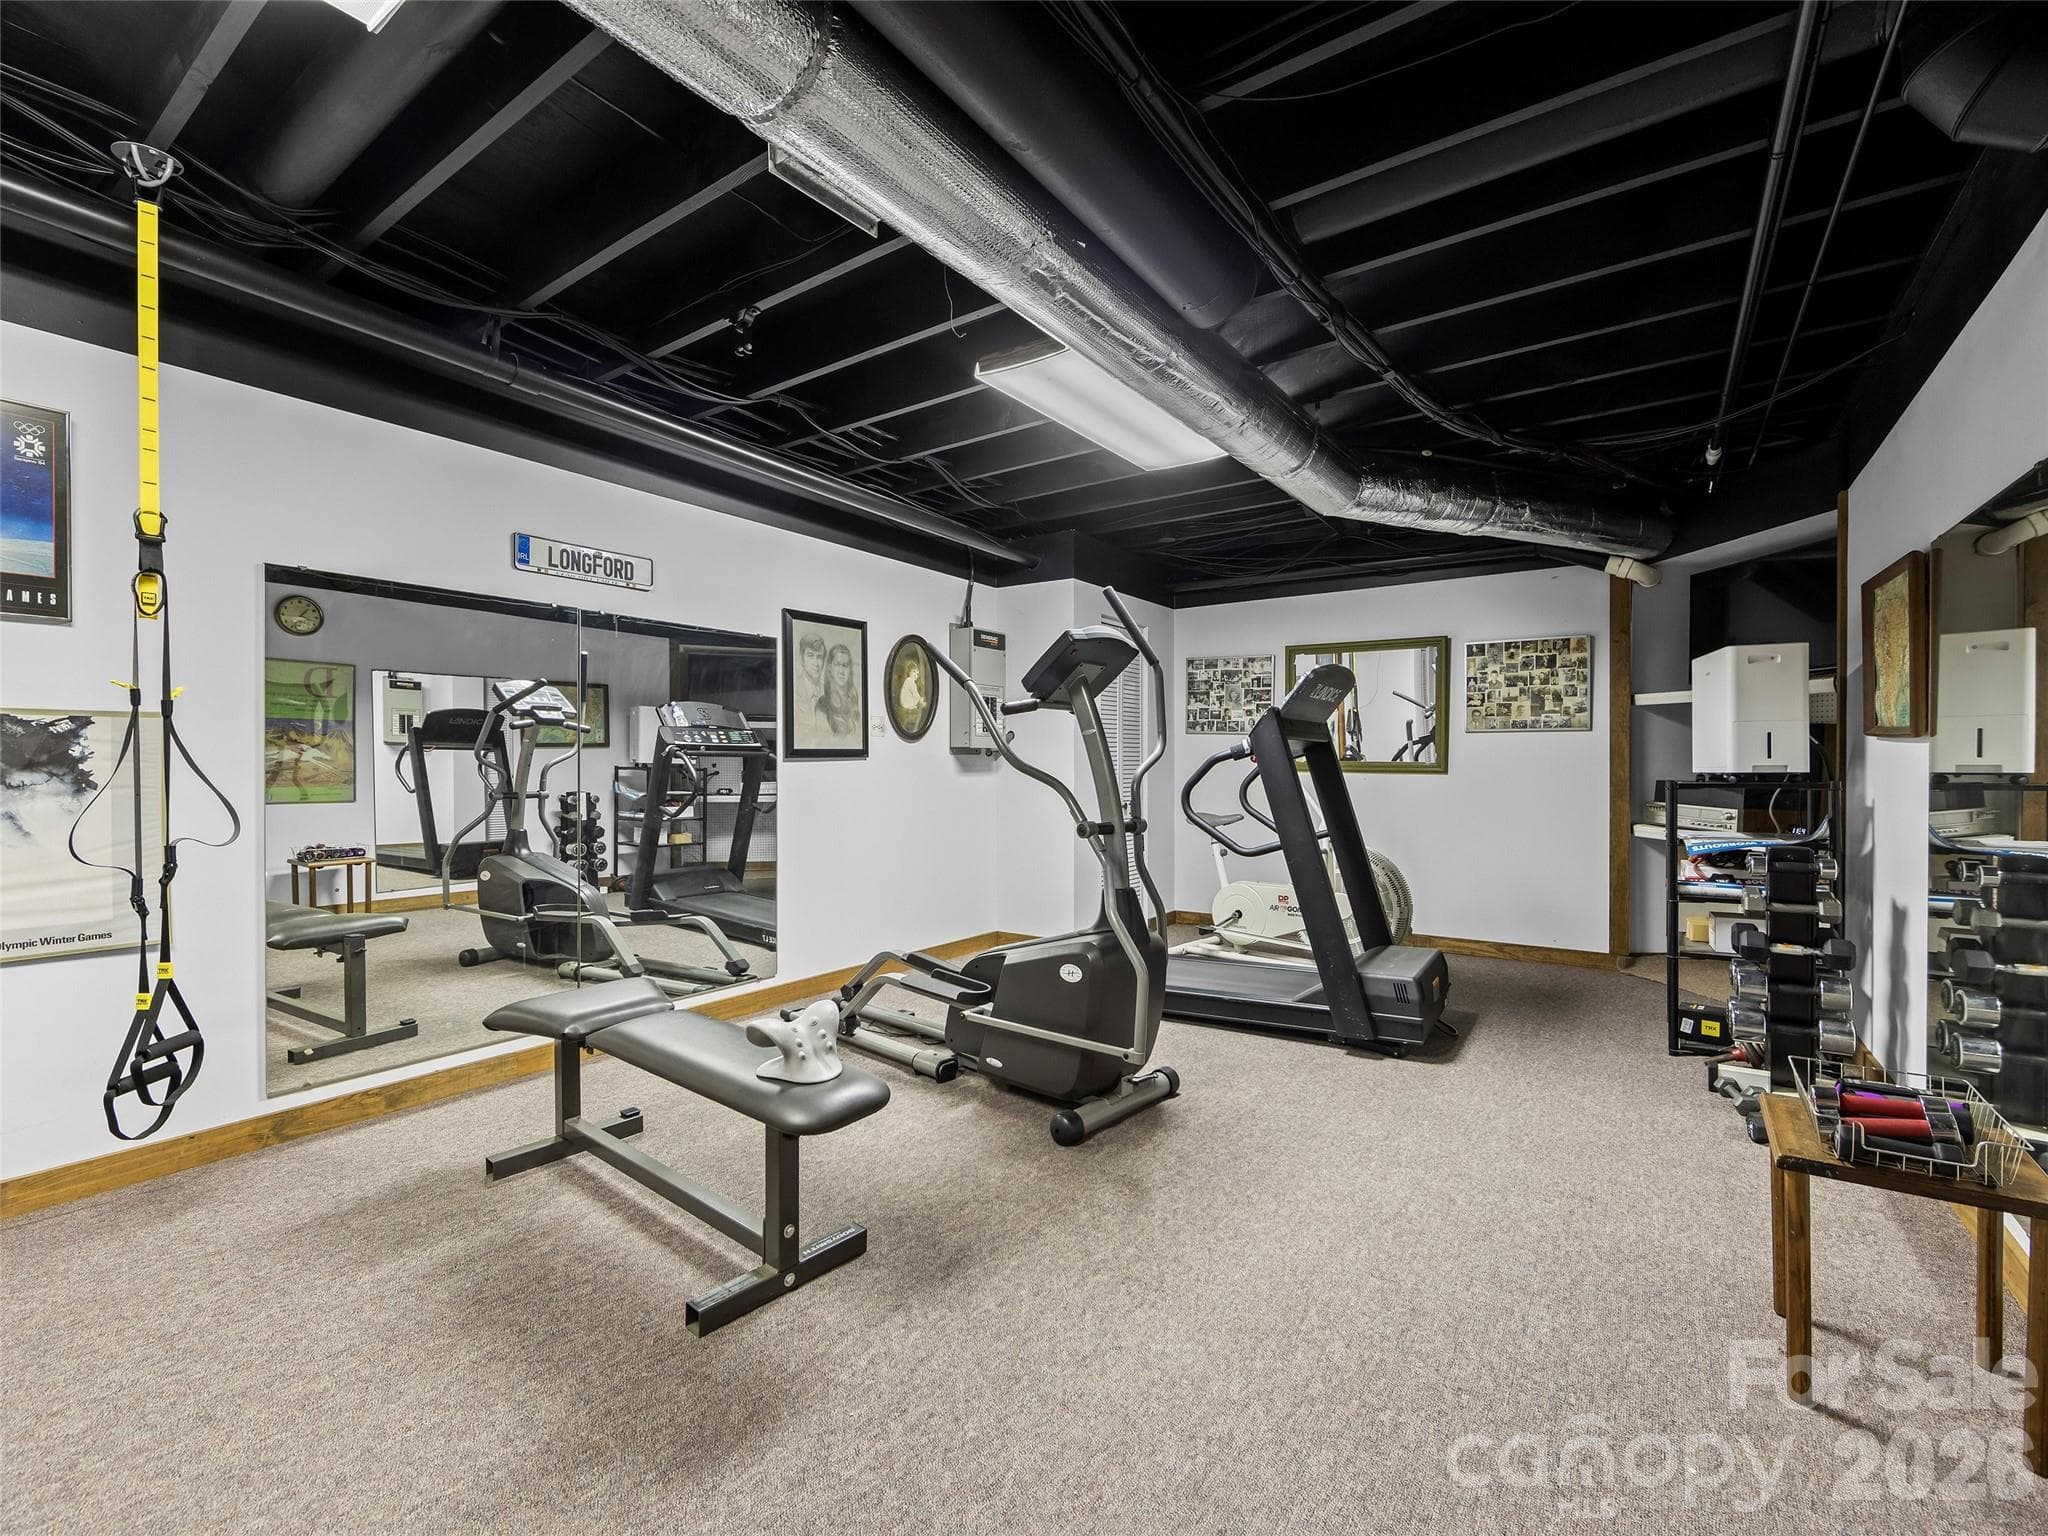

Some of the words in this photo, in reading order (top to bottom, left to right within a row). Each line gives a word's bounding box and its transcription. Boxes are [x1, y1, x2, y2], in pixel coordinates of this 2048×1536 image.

[548, 546, 634, 581] LONGFORD
[6, 589, 57, 605] AMES
[448, 717, 484, 725] LANDIC
[1691, 841, 1758, 852] WORKOUTS
[40, 936, 76, 946] Winter
[77, 931, 113, 943] Games
